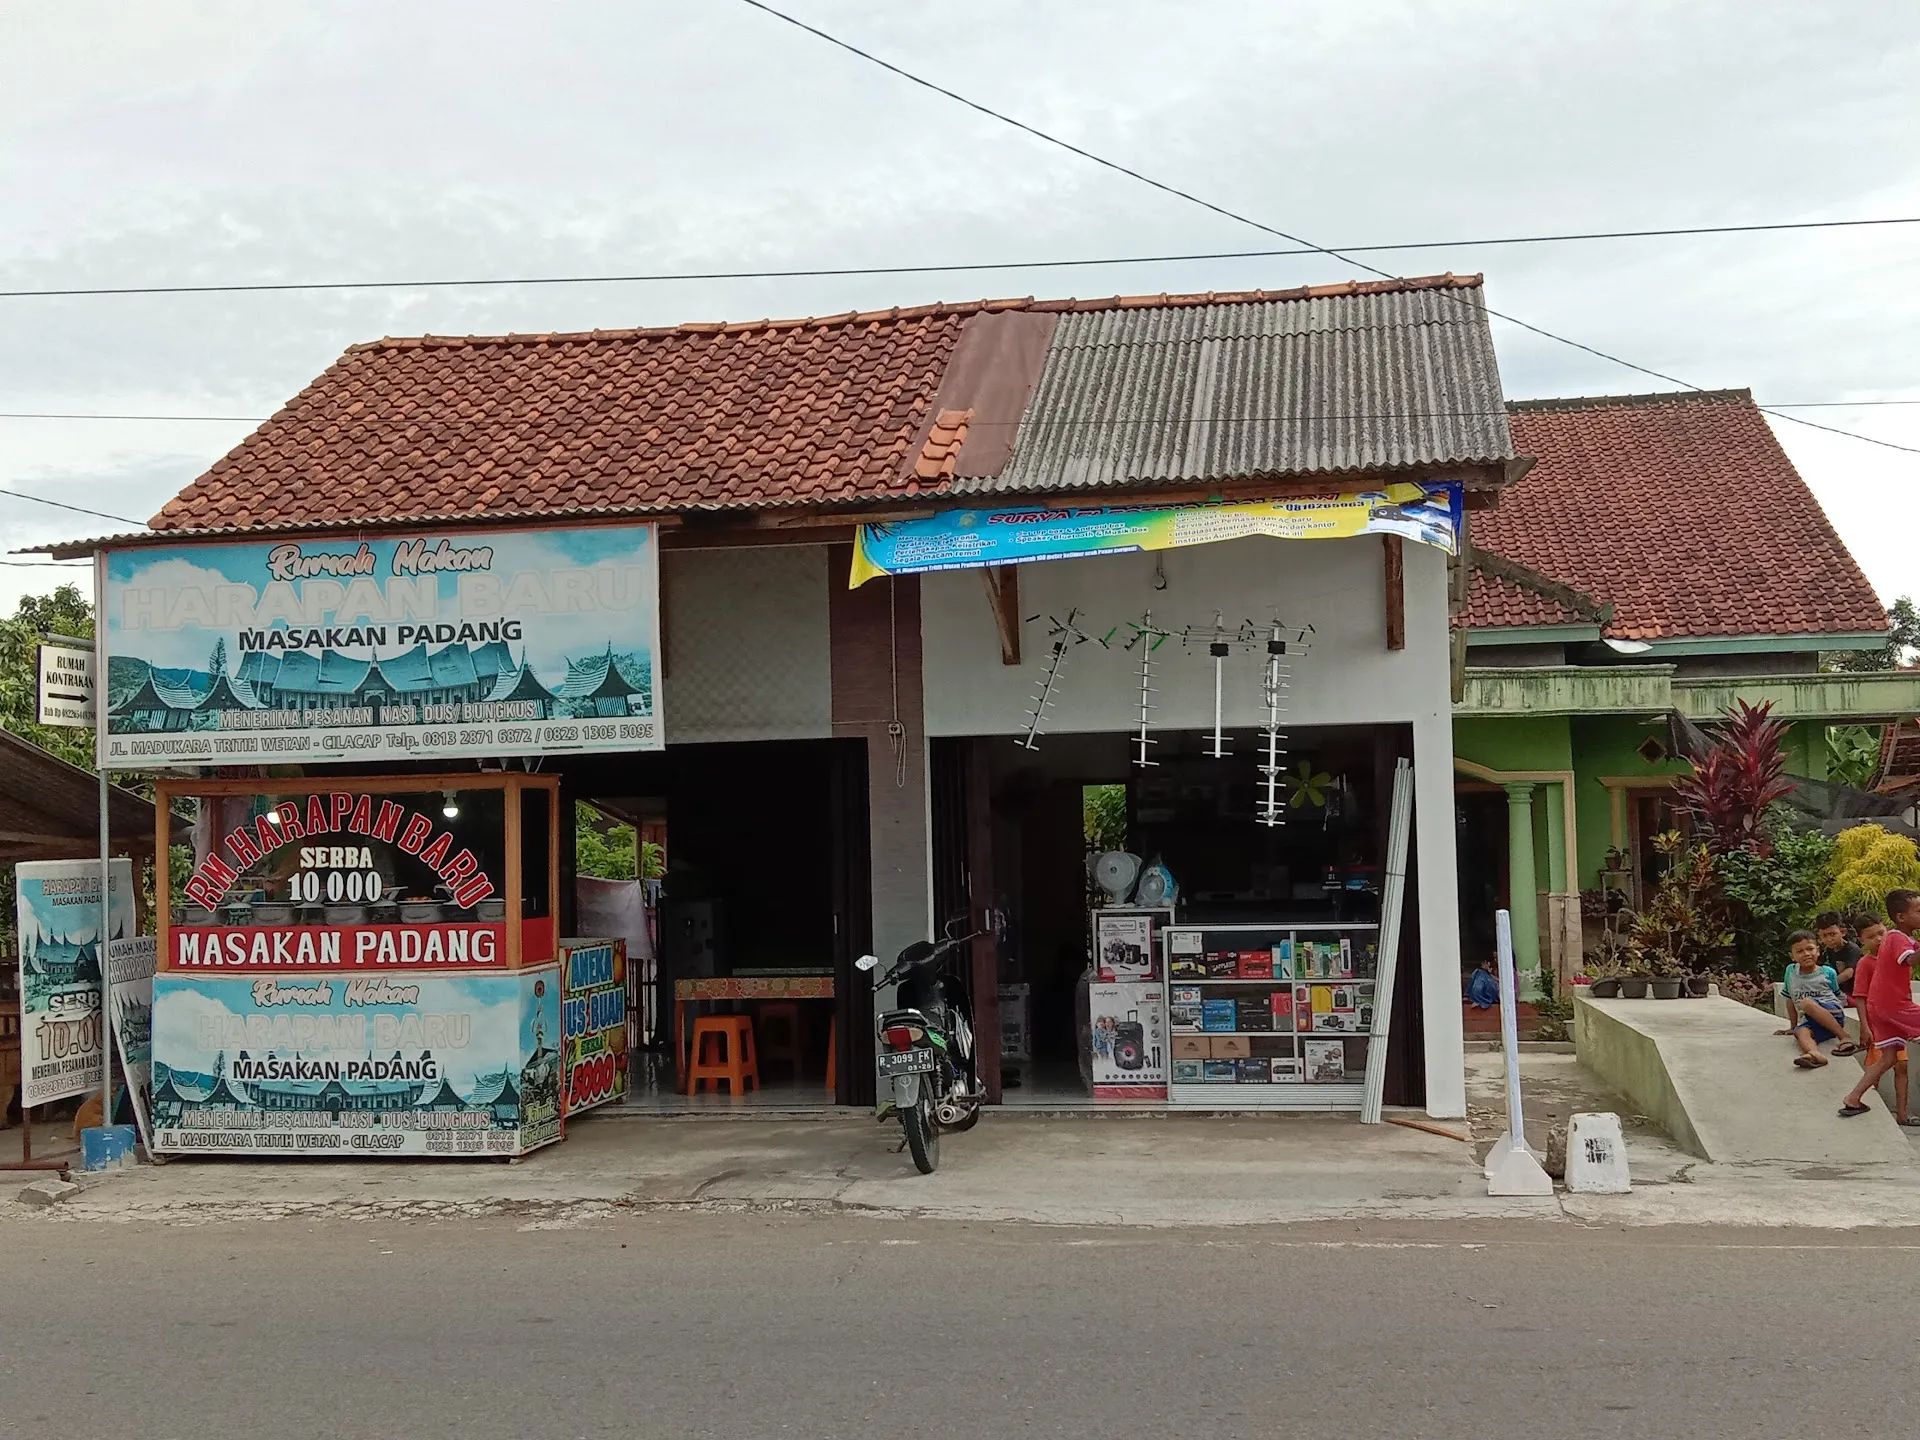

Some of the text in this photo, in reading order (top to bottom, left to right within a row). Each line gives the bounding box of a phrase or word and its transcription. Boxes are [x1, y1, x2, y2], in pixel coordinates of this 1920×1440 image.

[988, 510, 1069, 525] SURYA
[1307, 521, 1336, 529] kantor
[1016, 534, 1051, 544] Speaker
[1053, 530, 1094, 540] Bluetooth
[1104, 528, 1130, 536] Musik
[1074, 523, 1107, 532] Android
[1213, 532, 1237, 540] Audio
[951, 539, 997, 549] Kelistrikan
[266, 538, 493, 581] Rumah Makan
[894, 549, 981, 564] Segala macam remot
[122, 566, 643, 631] HARAPAN BARU
[239, 618, 522, 650] MASAKAN PADANG
[57, 655, 85, 672] RUMAH
[46, 670, 94, 689] KONTRAKAN
[219, 709, 301, 729] MENERIMA
[303, 707, 374, 726] PESANAN
[379, 704, 417, 724] NASI
[131, 739, 213, 756] MADUKARA
[214, 737, 258, 752] TRITIH
[260, 736, 311, 752] WETAN
[322, 733, 382, 749] CILACAP
[386, 733, 420, 750] Telp.
[422, 731, 457, 746] 0813
[460, 730, 493, 745] 2871
[497, 728, 533, 743] 6872
[544, 726, 578, 742] 0823
[582, 724, 617, 740] 1305
[619, 723, 654, 739] 5095
[224, 791, 405, 870] HARAPAN
[397, 812, 496, 910] BARU
[299, 846, 374, 869] SERBA
[52, 894, 102, 907] MASAKAN PADA
[110, 942, 134, 958] UMAH
[178, 930, 341, 966] MASAKAN
[354, 928, 496, 964] PADANG
[571, 946, 614, 990] ANEKA
[48, 989, 101, 1012] SERB
[251, 979, 420, 1007] Rumah Makan
[590, 988, 625, 1032] BUAH
[200, 1013, 472, 1050] HARAPAN BARU
[891, 1053, 914, 1064] 3099
[918, 1050, 930, 1061] FK
[32, 1061, 61, 1080] MENERIMA
[62, 1056, 84, 1074] PESANAN
[233, 1060, 437, 1080] MASAKAN PADANG
[569, 1052, 615, 1110] 5000
[183, 1110, 264, 1128] MENERIMA
[265, 1110, 332, 1128] PESANAN
[339, 1111, 374, 1129] NASI
[161, 1133, 177, 1146] JL.
[180, 1133, 252, 1147] MADUKARA
[254, 1133, 294, 1147] TRITIH
[295, 1134, 340, 1148] WETAN
[350, 1134, 405, 1148] CILACAP
[425, 1131, 515, 1141] 0813 2871 6872
[425, 1141, 515, 1150] 0823 1305 5095
